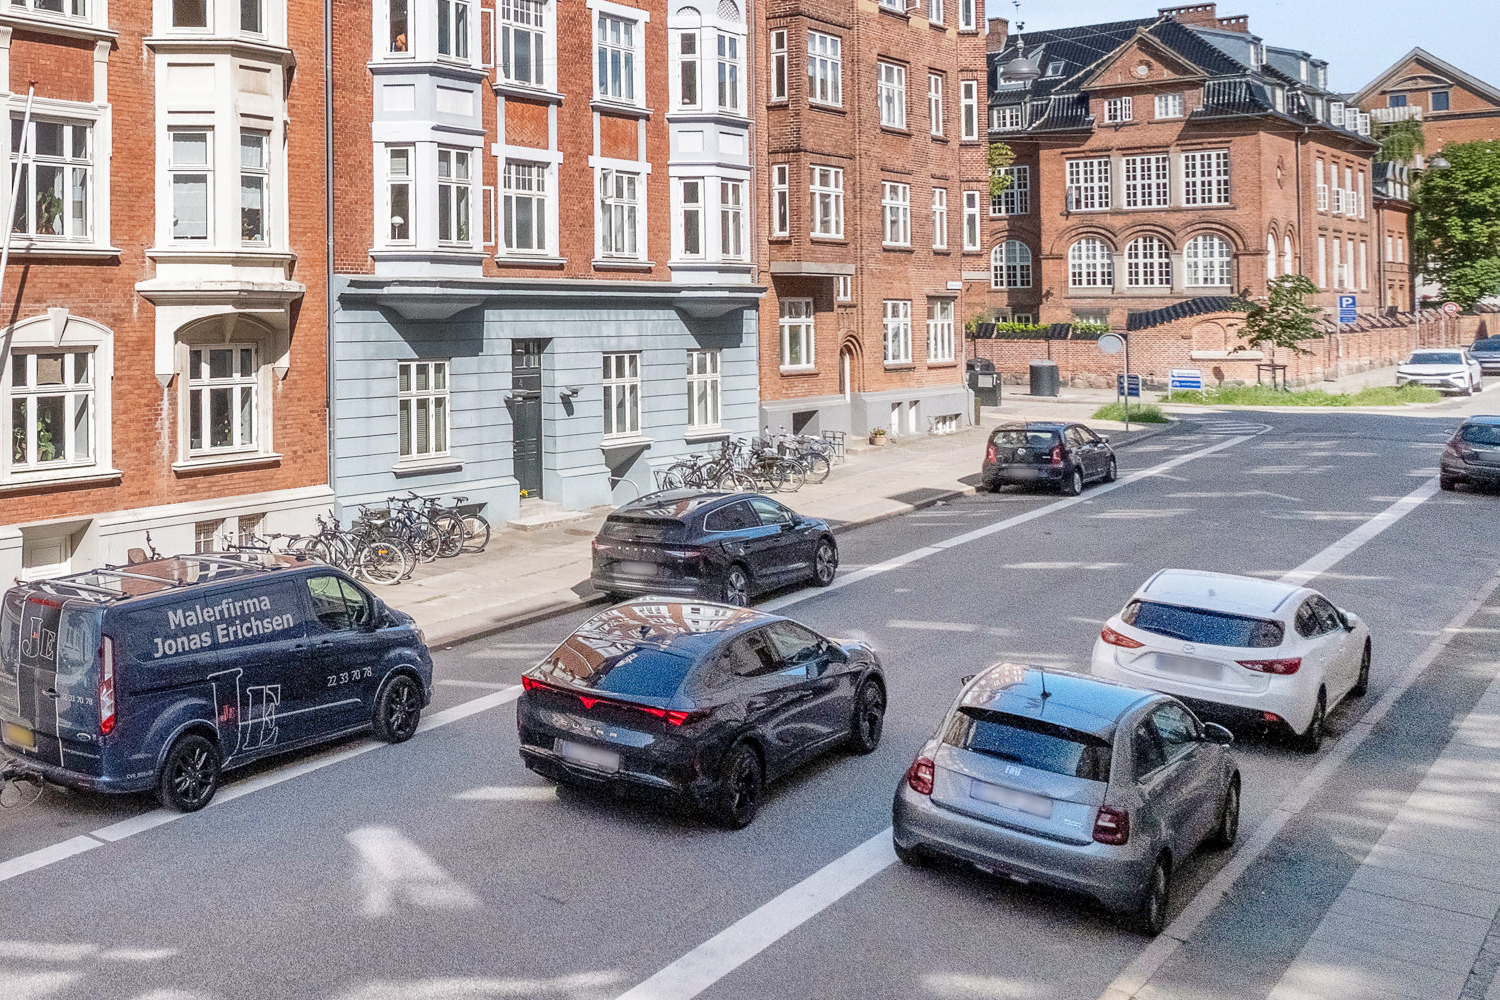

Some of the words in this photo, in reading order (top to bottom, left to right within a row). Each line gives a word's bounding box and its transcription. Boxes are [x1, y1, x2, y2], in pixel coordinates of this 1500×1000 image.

[1342, 297, 1353, 307] P
[167, 596, 271, 630] Malerfirma
[153, 631, 212, 658] Jonas
[216, 613, 294, 644] Erichsen
[327, 675, 338, 687] 22
[339, 672, 349, 684] 33
[351, 669, 361, 681] 70
[362, 666, 372, 678] 78
[76, 696, 84, 704] 70
[1005, 765, 1023, 777] FIAT
